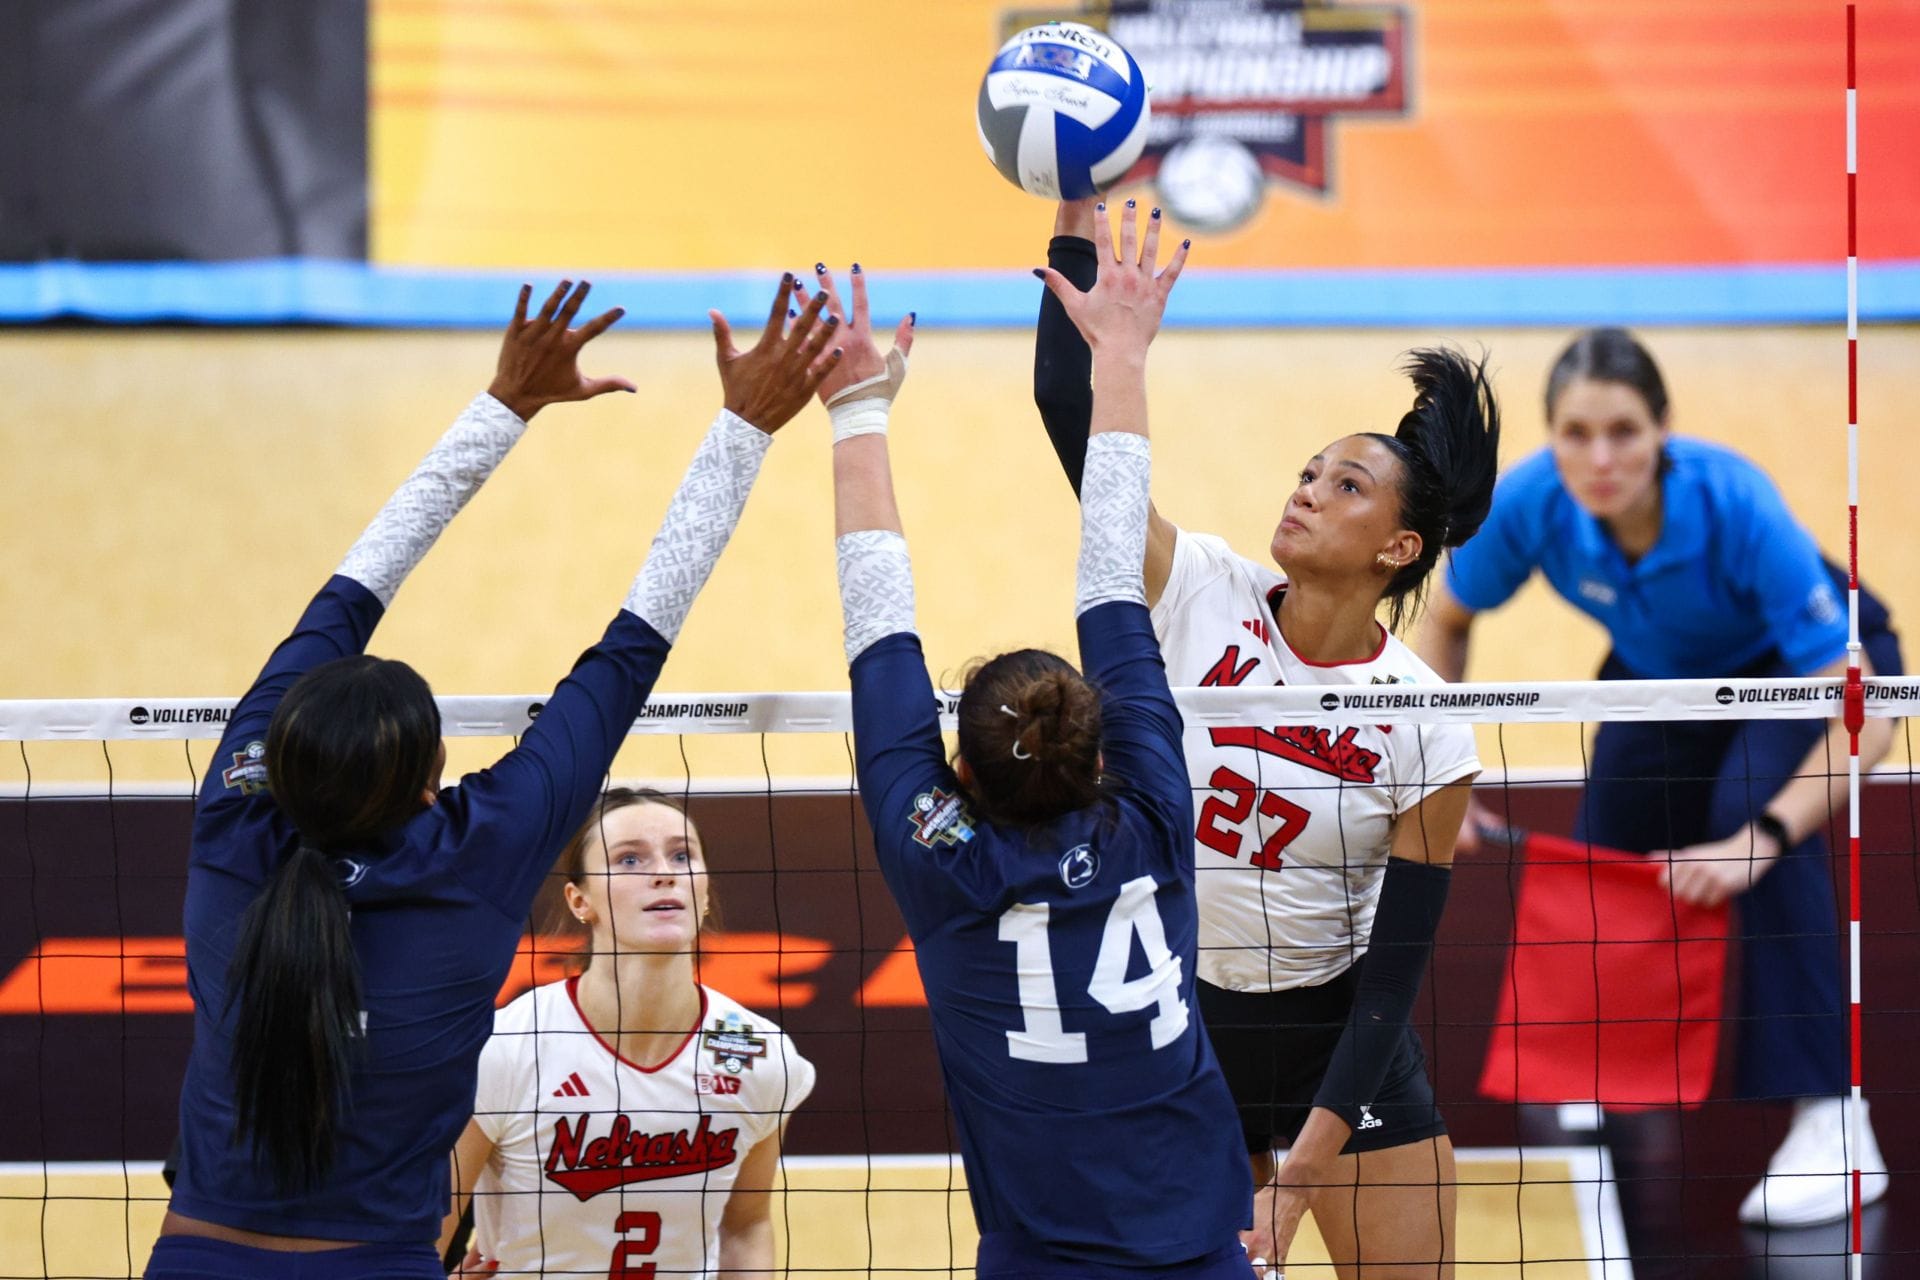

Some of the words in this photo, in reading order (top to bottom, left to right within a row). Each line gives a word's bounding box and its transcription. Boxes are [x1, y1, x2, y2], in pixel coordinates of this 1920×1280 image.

[1343, 693, 1425, 708] VOLLEYBALL
[1430, 692, 1540, 707] CHAMPIONSHIP
[1739, 688, 1820, 702] VOLLEYBALL
[1195, 765, 1311, 872] 27
[998, 874, 1190, 1064] 14
[544, 1112, 739, 1173] Nebraska
[607, 1211, 662, 1280] 2
